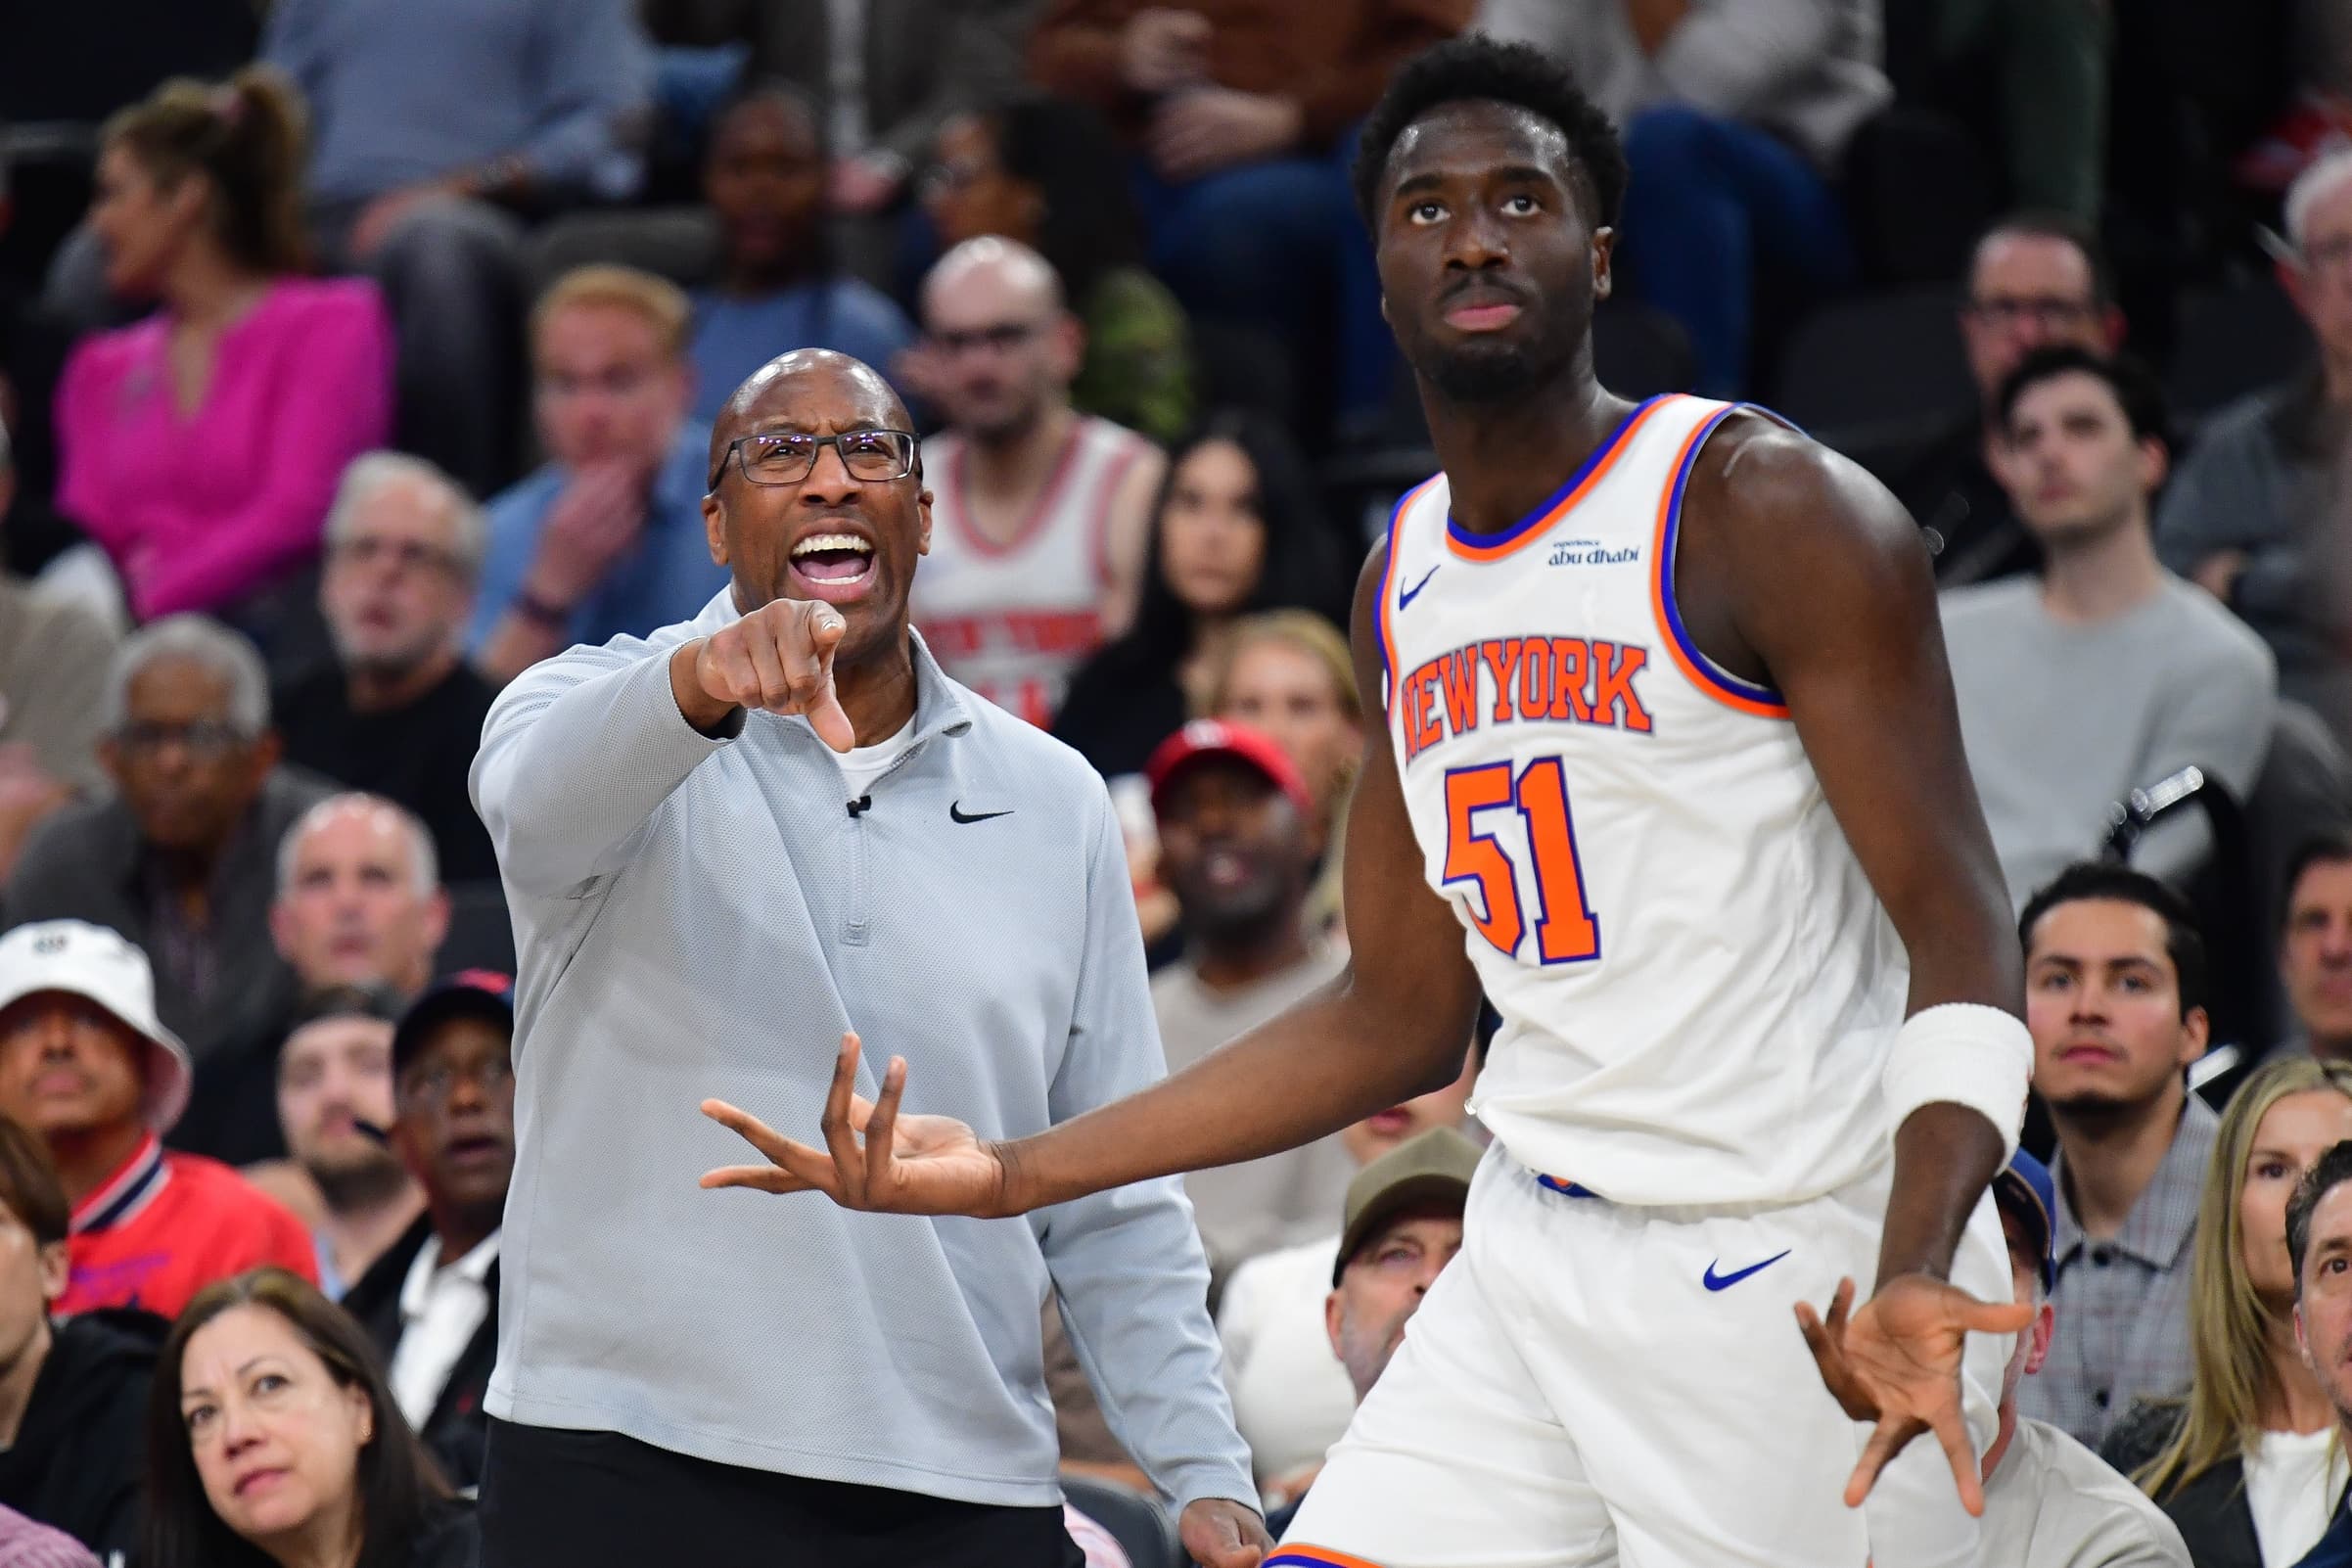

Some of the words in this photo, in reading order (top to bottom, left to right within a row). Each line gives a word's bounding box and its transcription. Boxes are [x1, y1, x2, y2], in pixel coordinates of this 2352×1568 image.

[1548, 550, 1582, 566] abu
[1587, 546, 1639, 565] dhabi
[1402, 644, 1479, 767] NEW
[1481, 636, 1655, 736] YORK
[1442, 754, 1600, 966] 51
